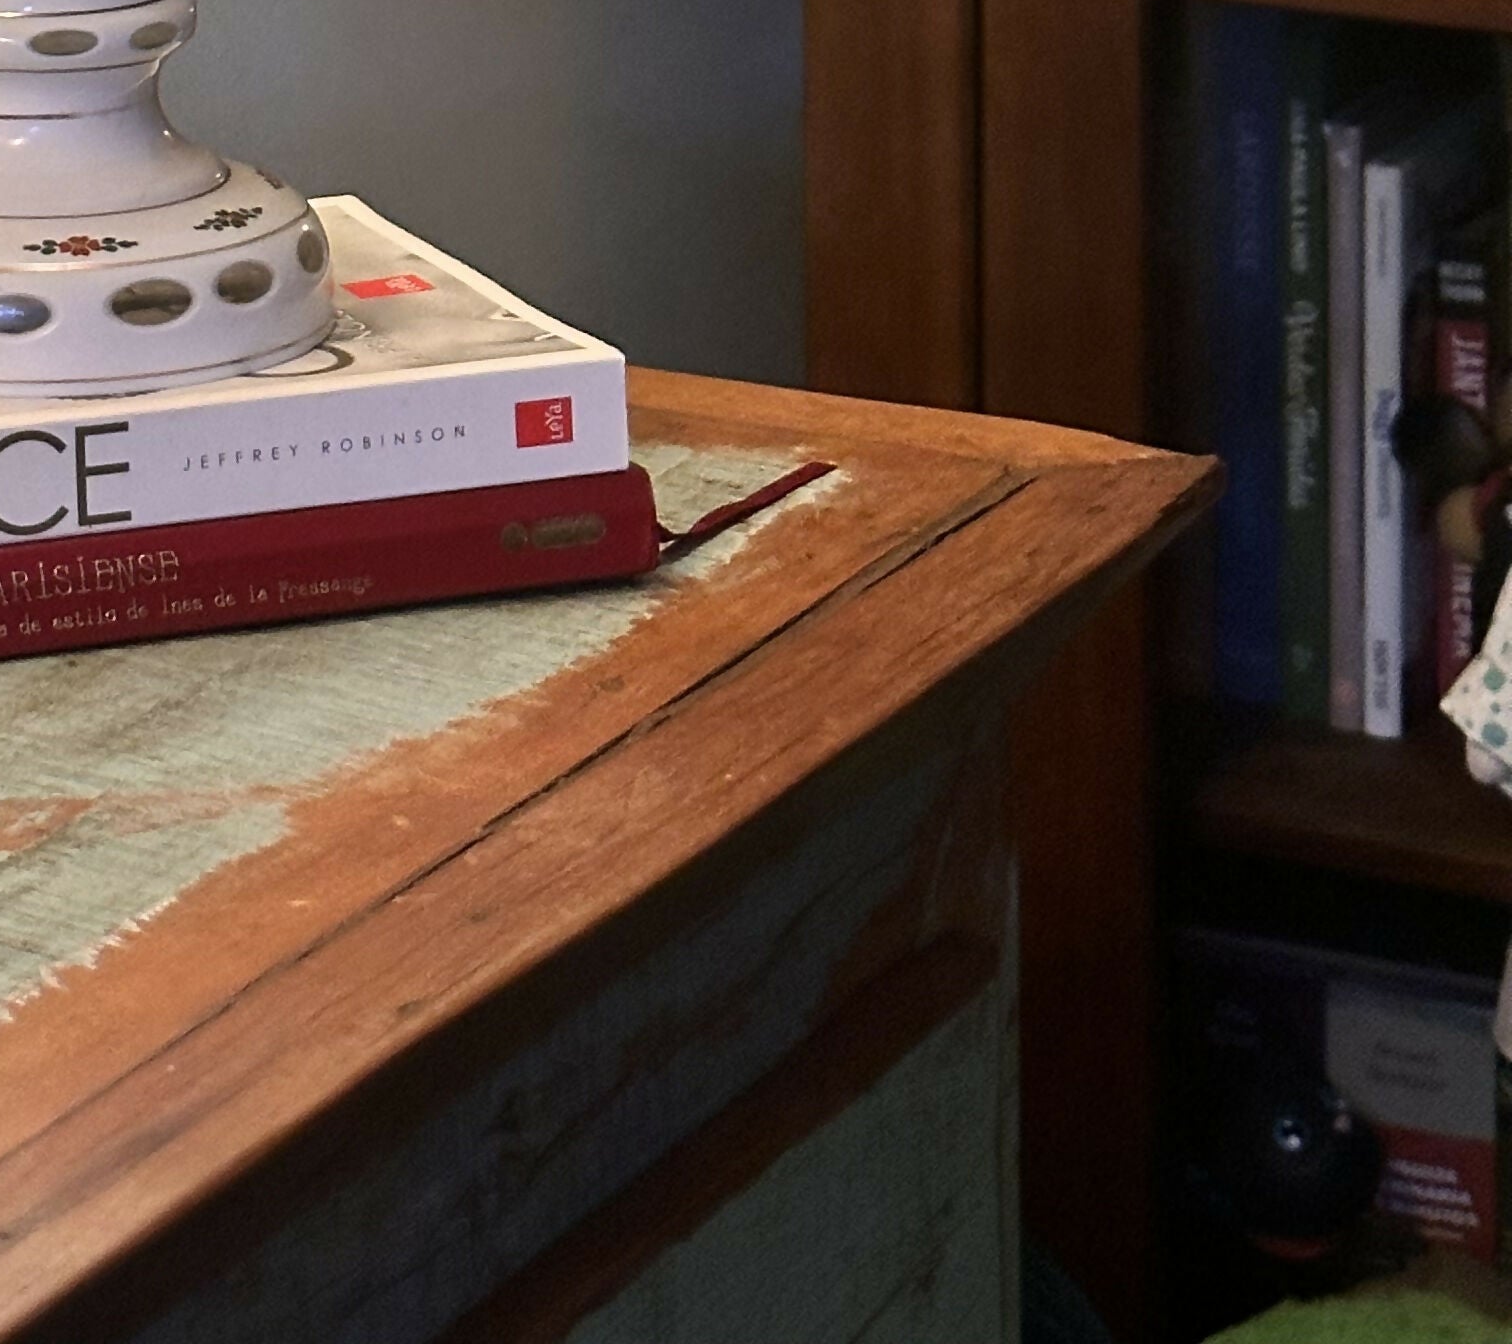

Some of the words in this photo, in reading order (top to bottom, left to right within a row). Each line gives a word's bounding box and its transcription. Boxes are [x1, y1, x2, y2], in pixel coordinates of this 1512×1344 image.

[182, 443, 299, 473] JEFFREY
[321, 424, 468, 455] ROBINSON
[18, 614, 42, 636] de
[52, 608, 118, 631] estilo
[126, 598, 149, 621] de
[214, 586, 237, 609] de
[249, 583, 269, 604] la
